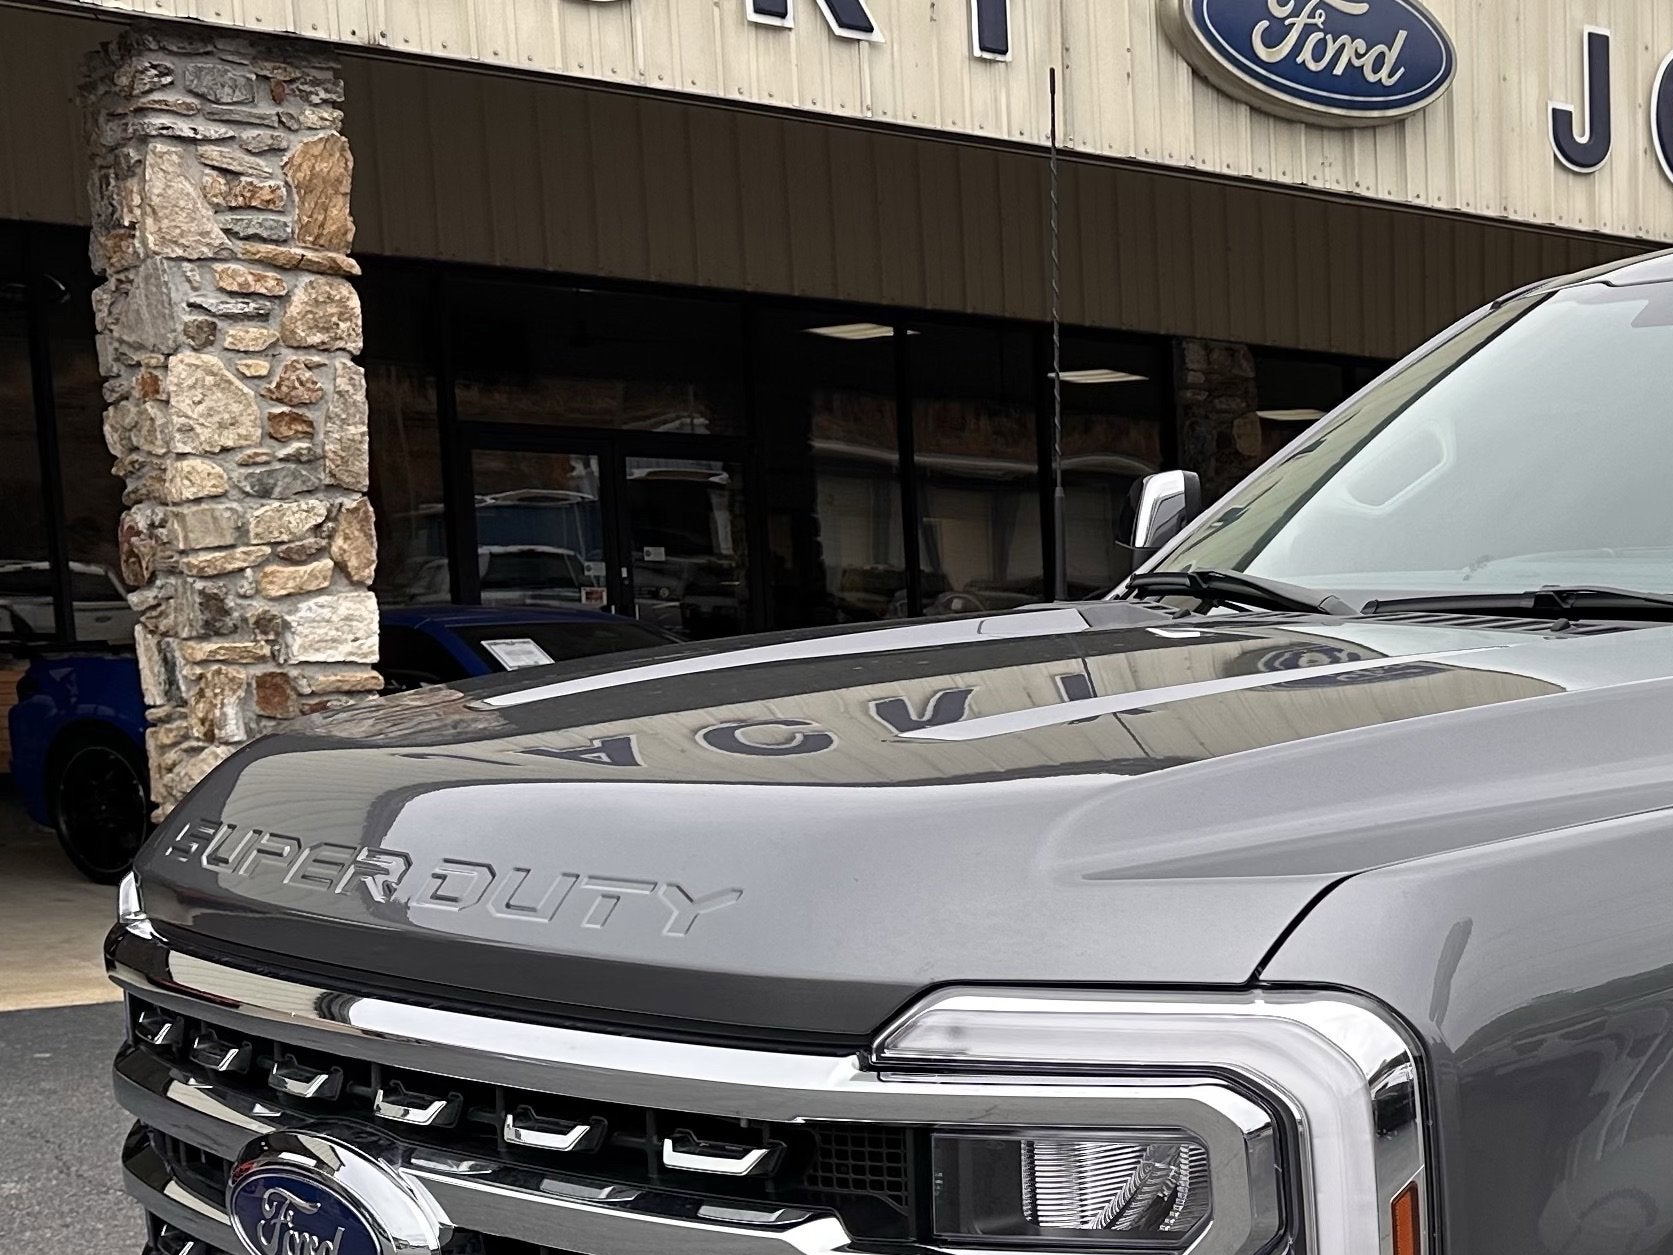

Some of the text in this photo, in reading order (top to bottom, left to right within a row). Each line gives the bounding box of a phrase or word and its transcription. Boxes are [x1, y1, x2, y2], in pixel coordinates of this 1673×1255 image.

[1252, 0, 1406, 87] Ford
[165, 820, 744, 937] SUPER DUTY
